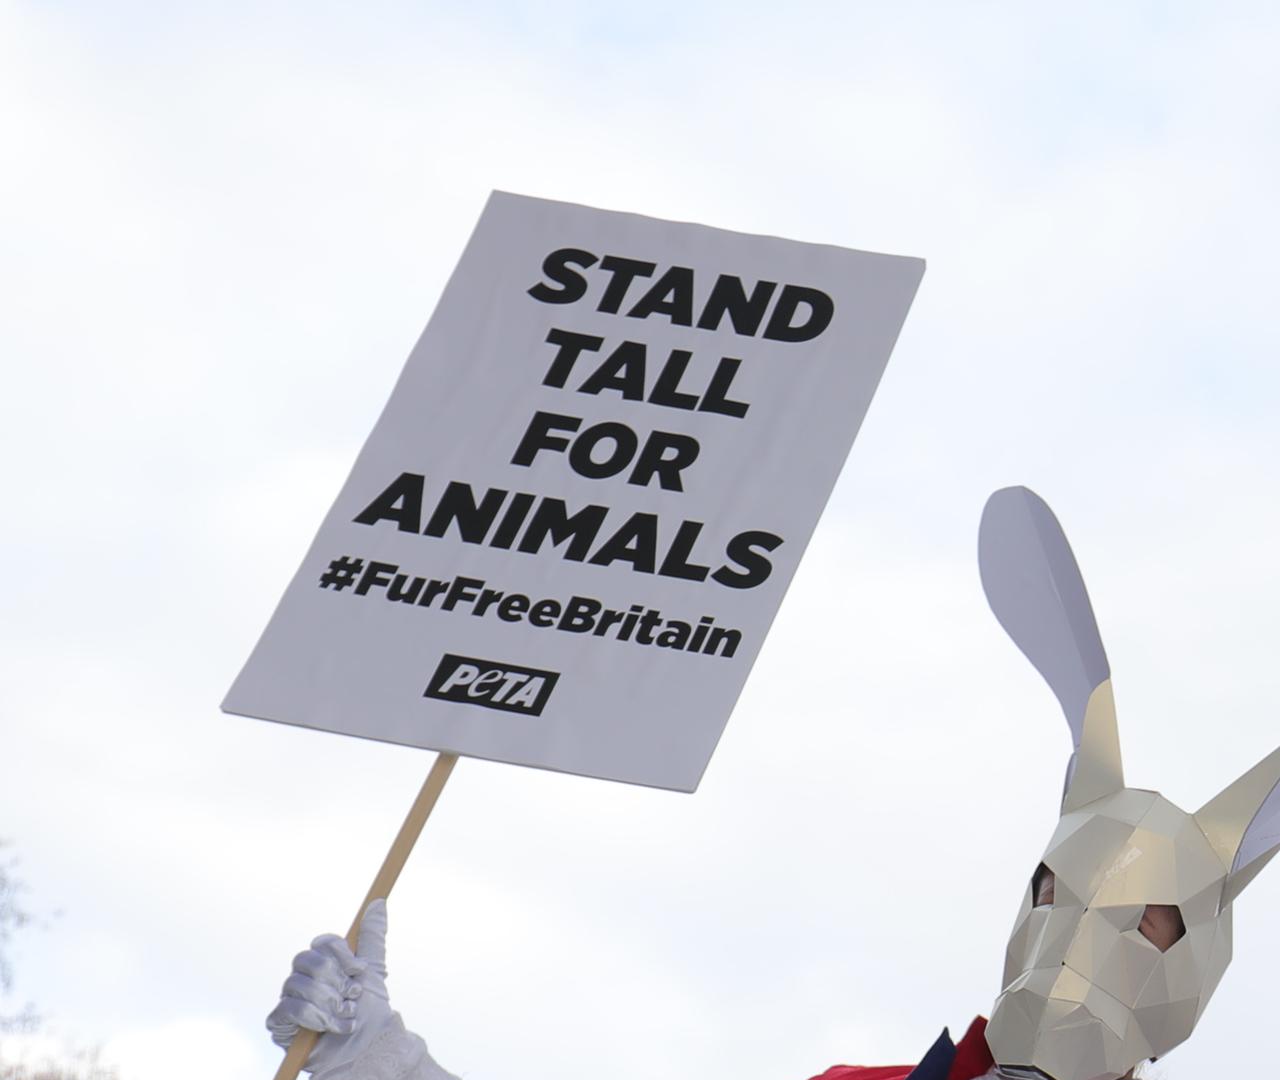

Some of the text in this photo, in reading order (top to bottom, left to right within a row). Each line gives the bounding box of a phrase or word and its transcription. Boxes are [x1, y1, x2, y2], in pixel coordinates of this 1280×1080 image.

[527, 248, 835, 343] STAND
[542, 327, 750, 419] TALL
[510, 410, 701, 493] FOR
[352, 472, 784, 590] ANIMALS
[319, 556, 742, 662] #FurFreeBritain
